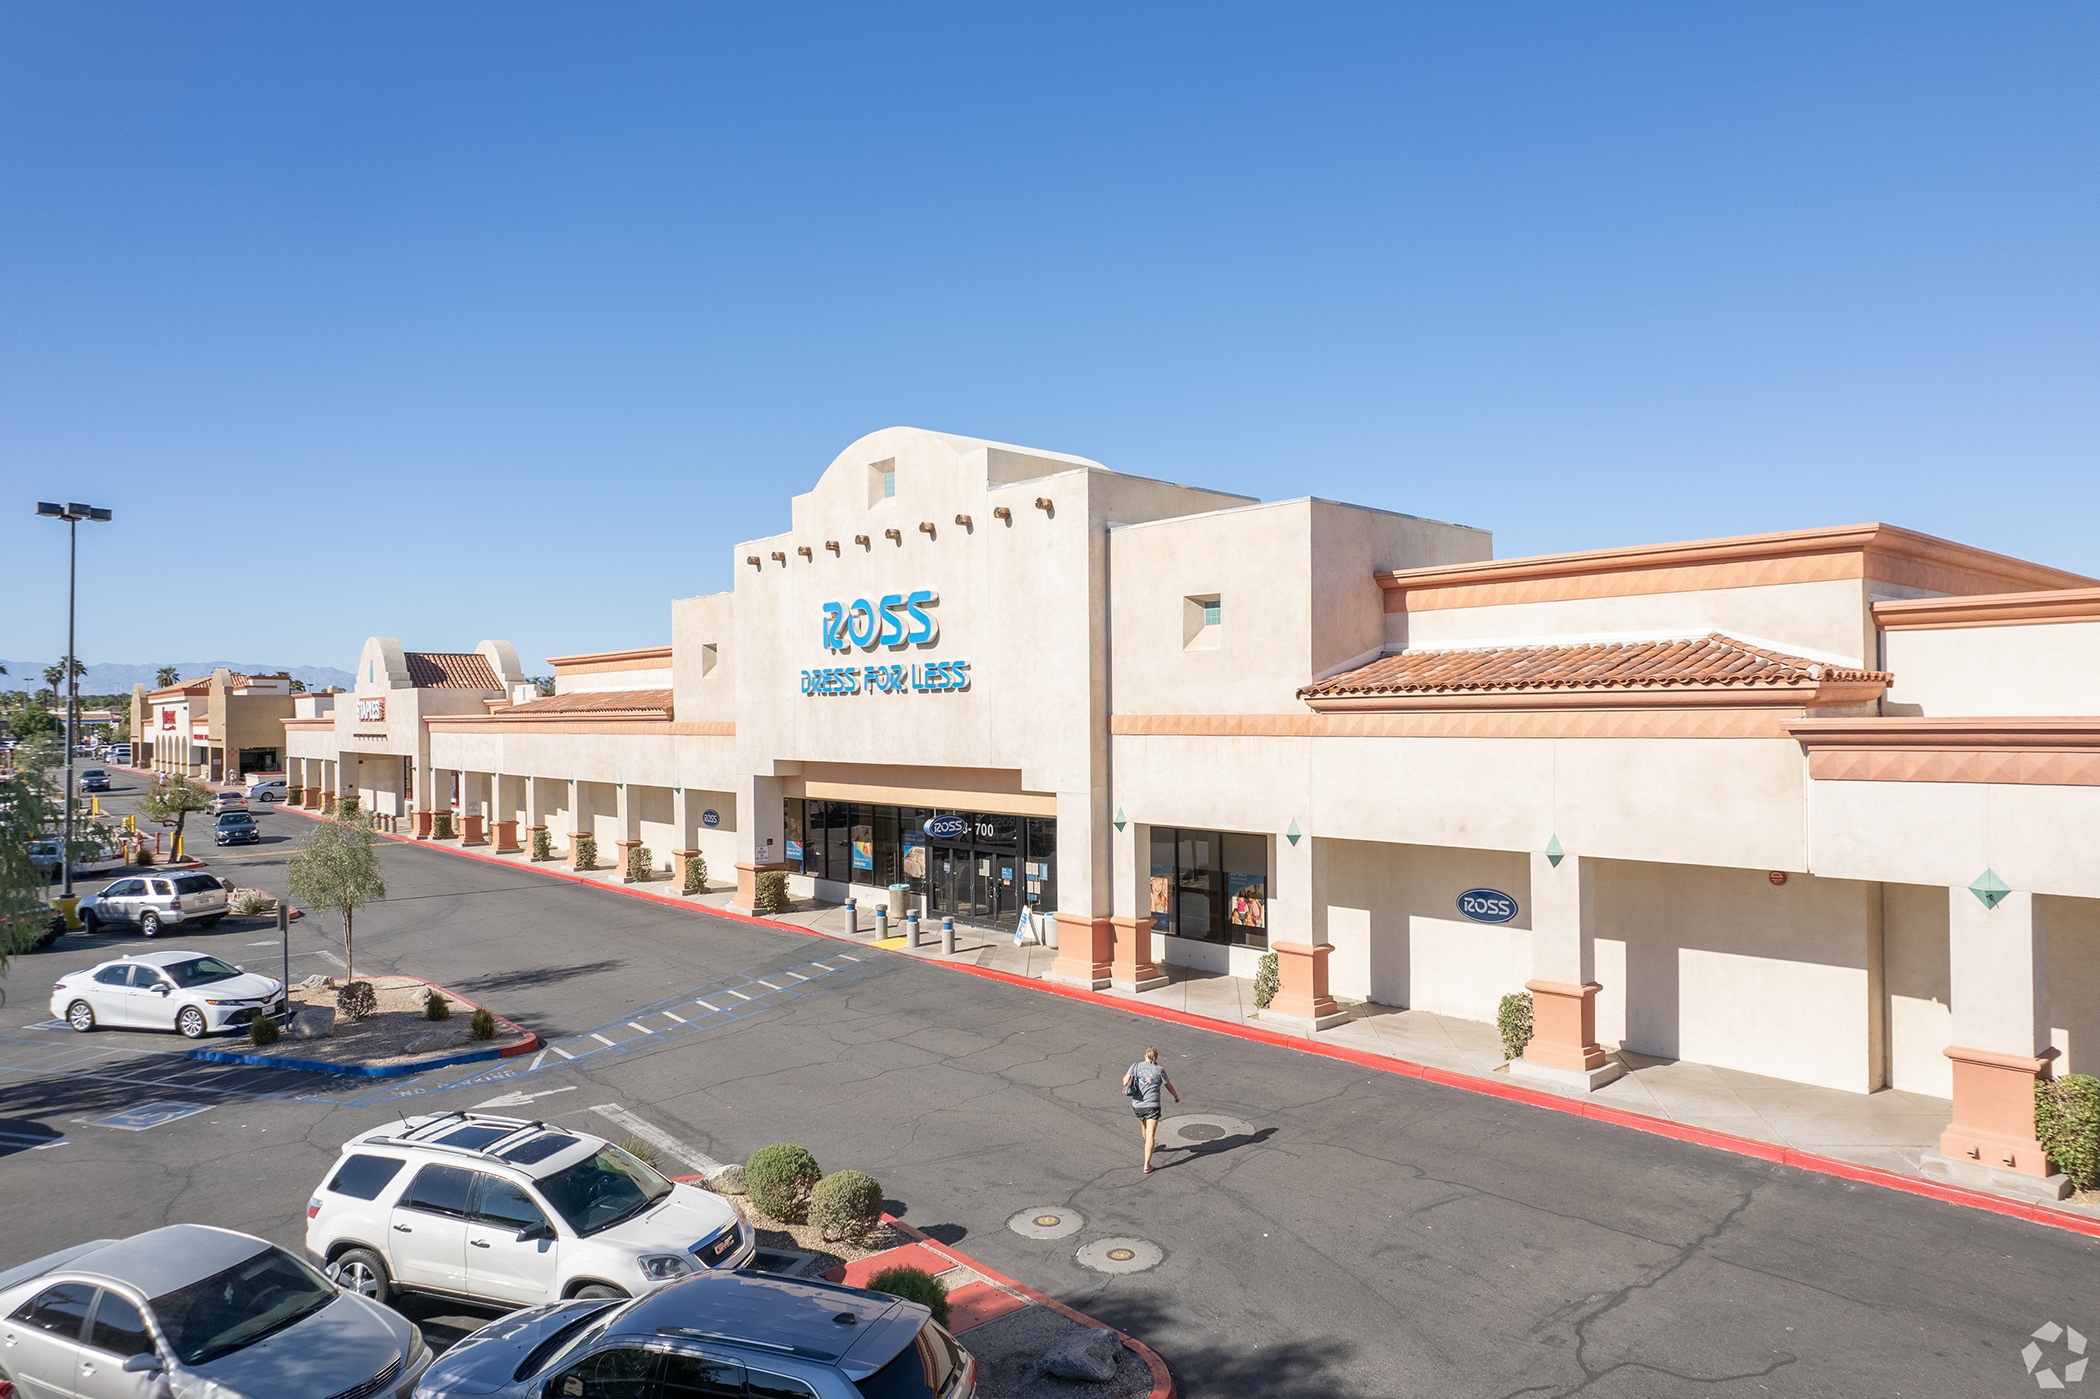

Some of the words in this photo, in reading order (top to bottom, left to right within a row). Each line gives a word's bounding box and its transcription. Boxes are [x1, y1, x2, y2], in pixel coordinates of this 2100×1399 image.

[822, 590, 937, 650] ROSS
[801, 667, 858, 694] DRESS
[864, 665, 906, 692] FOR
[912, 661, 968, 690] LESS
[356, 700, 383, 719] STAPLES
[704, 814, 718, 823] ROSS
[934, 820, 962, 833] ROSS
[1464, 897, 1510, 916] ROSS
[399, 1087, 427, 1097] NO
[714, 1234, 735, 1255] GMC
